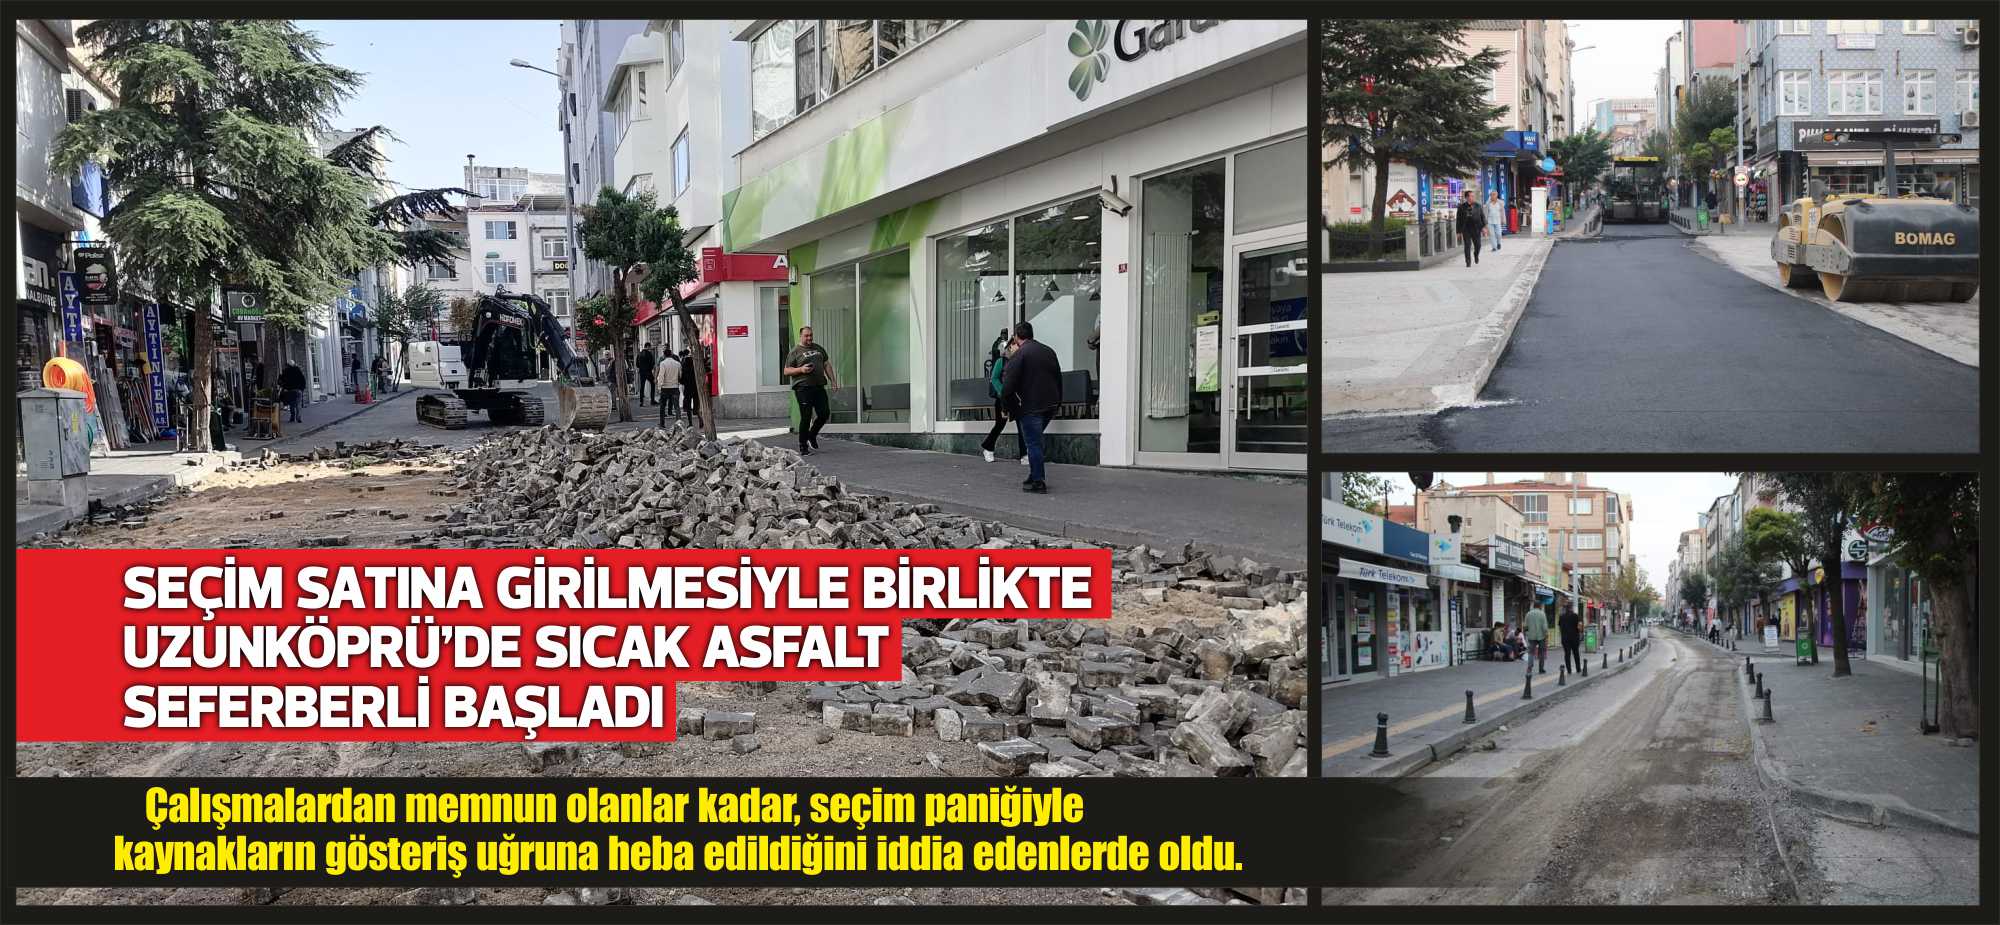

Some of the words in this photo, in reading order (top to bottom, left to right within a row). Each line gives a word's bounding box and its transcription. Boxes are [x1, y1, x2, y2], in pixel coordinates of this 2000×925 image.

[1894, 230, 1956, 247] BOMAG
[1359, 567, 1377, 578] Türk
[1379, 569, 1408, 583] Telekom
